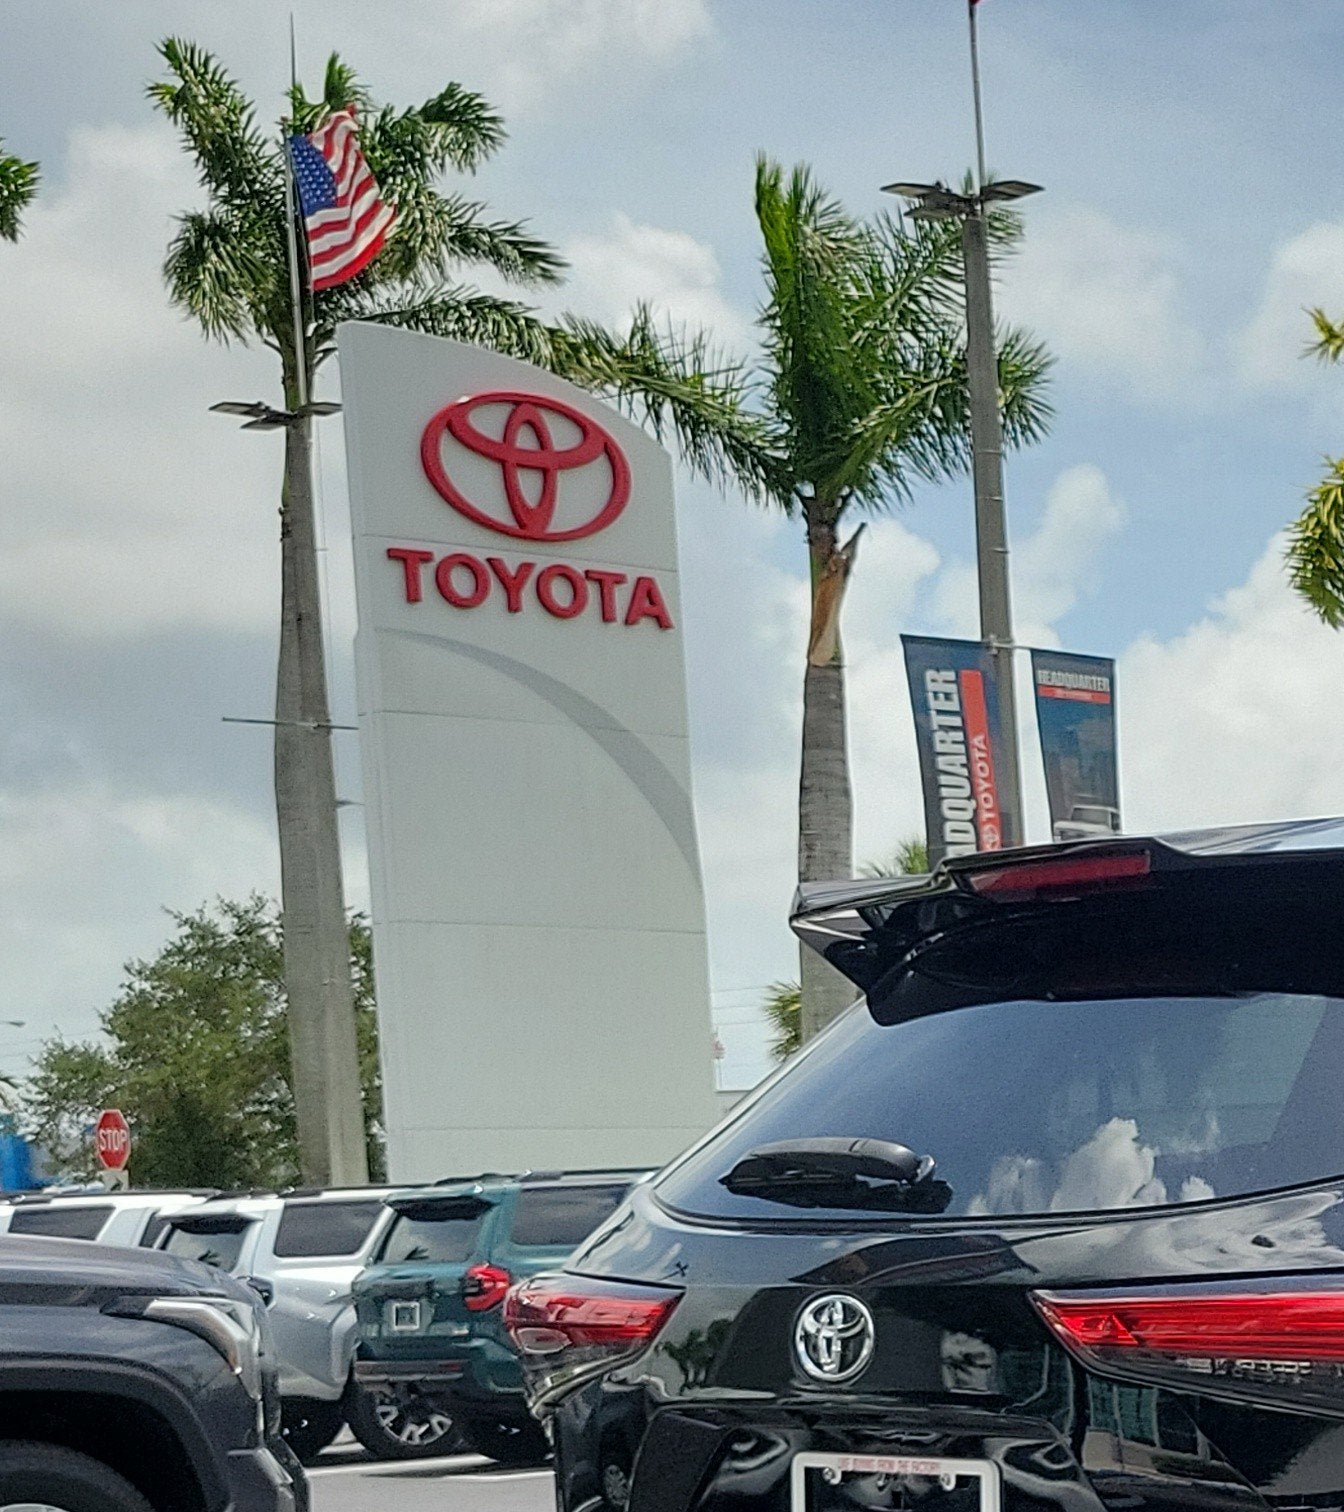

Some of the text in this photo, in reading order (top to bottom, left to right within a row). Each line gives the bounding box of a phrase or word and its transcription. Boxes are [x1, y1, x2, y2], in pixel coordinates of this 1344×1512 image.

[387, 548, 673, 629] TOYOTA
[926, 668, 977, 858] ADQUARTER
[972, 734, 996, 821] TOYOTA
[99, 1129, 128, 1151] STOP
